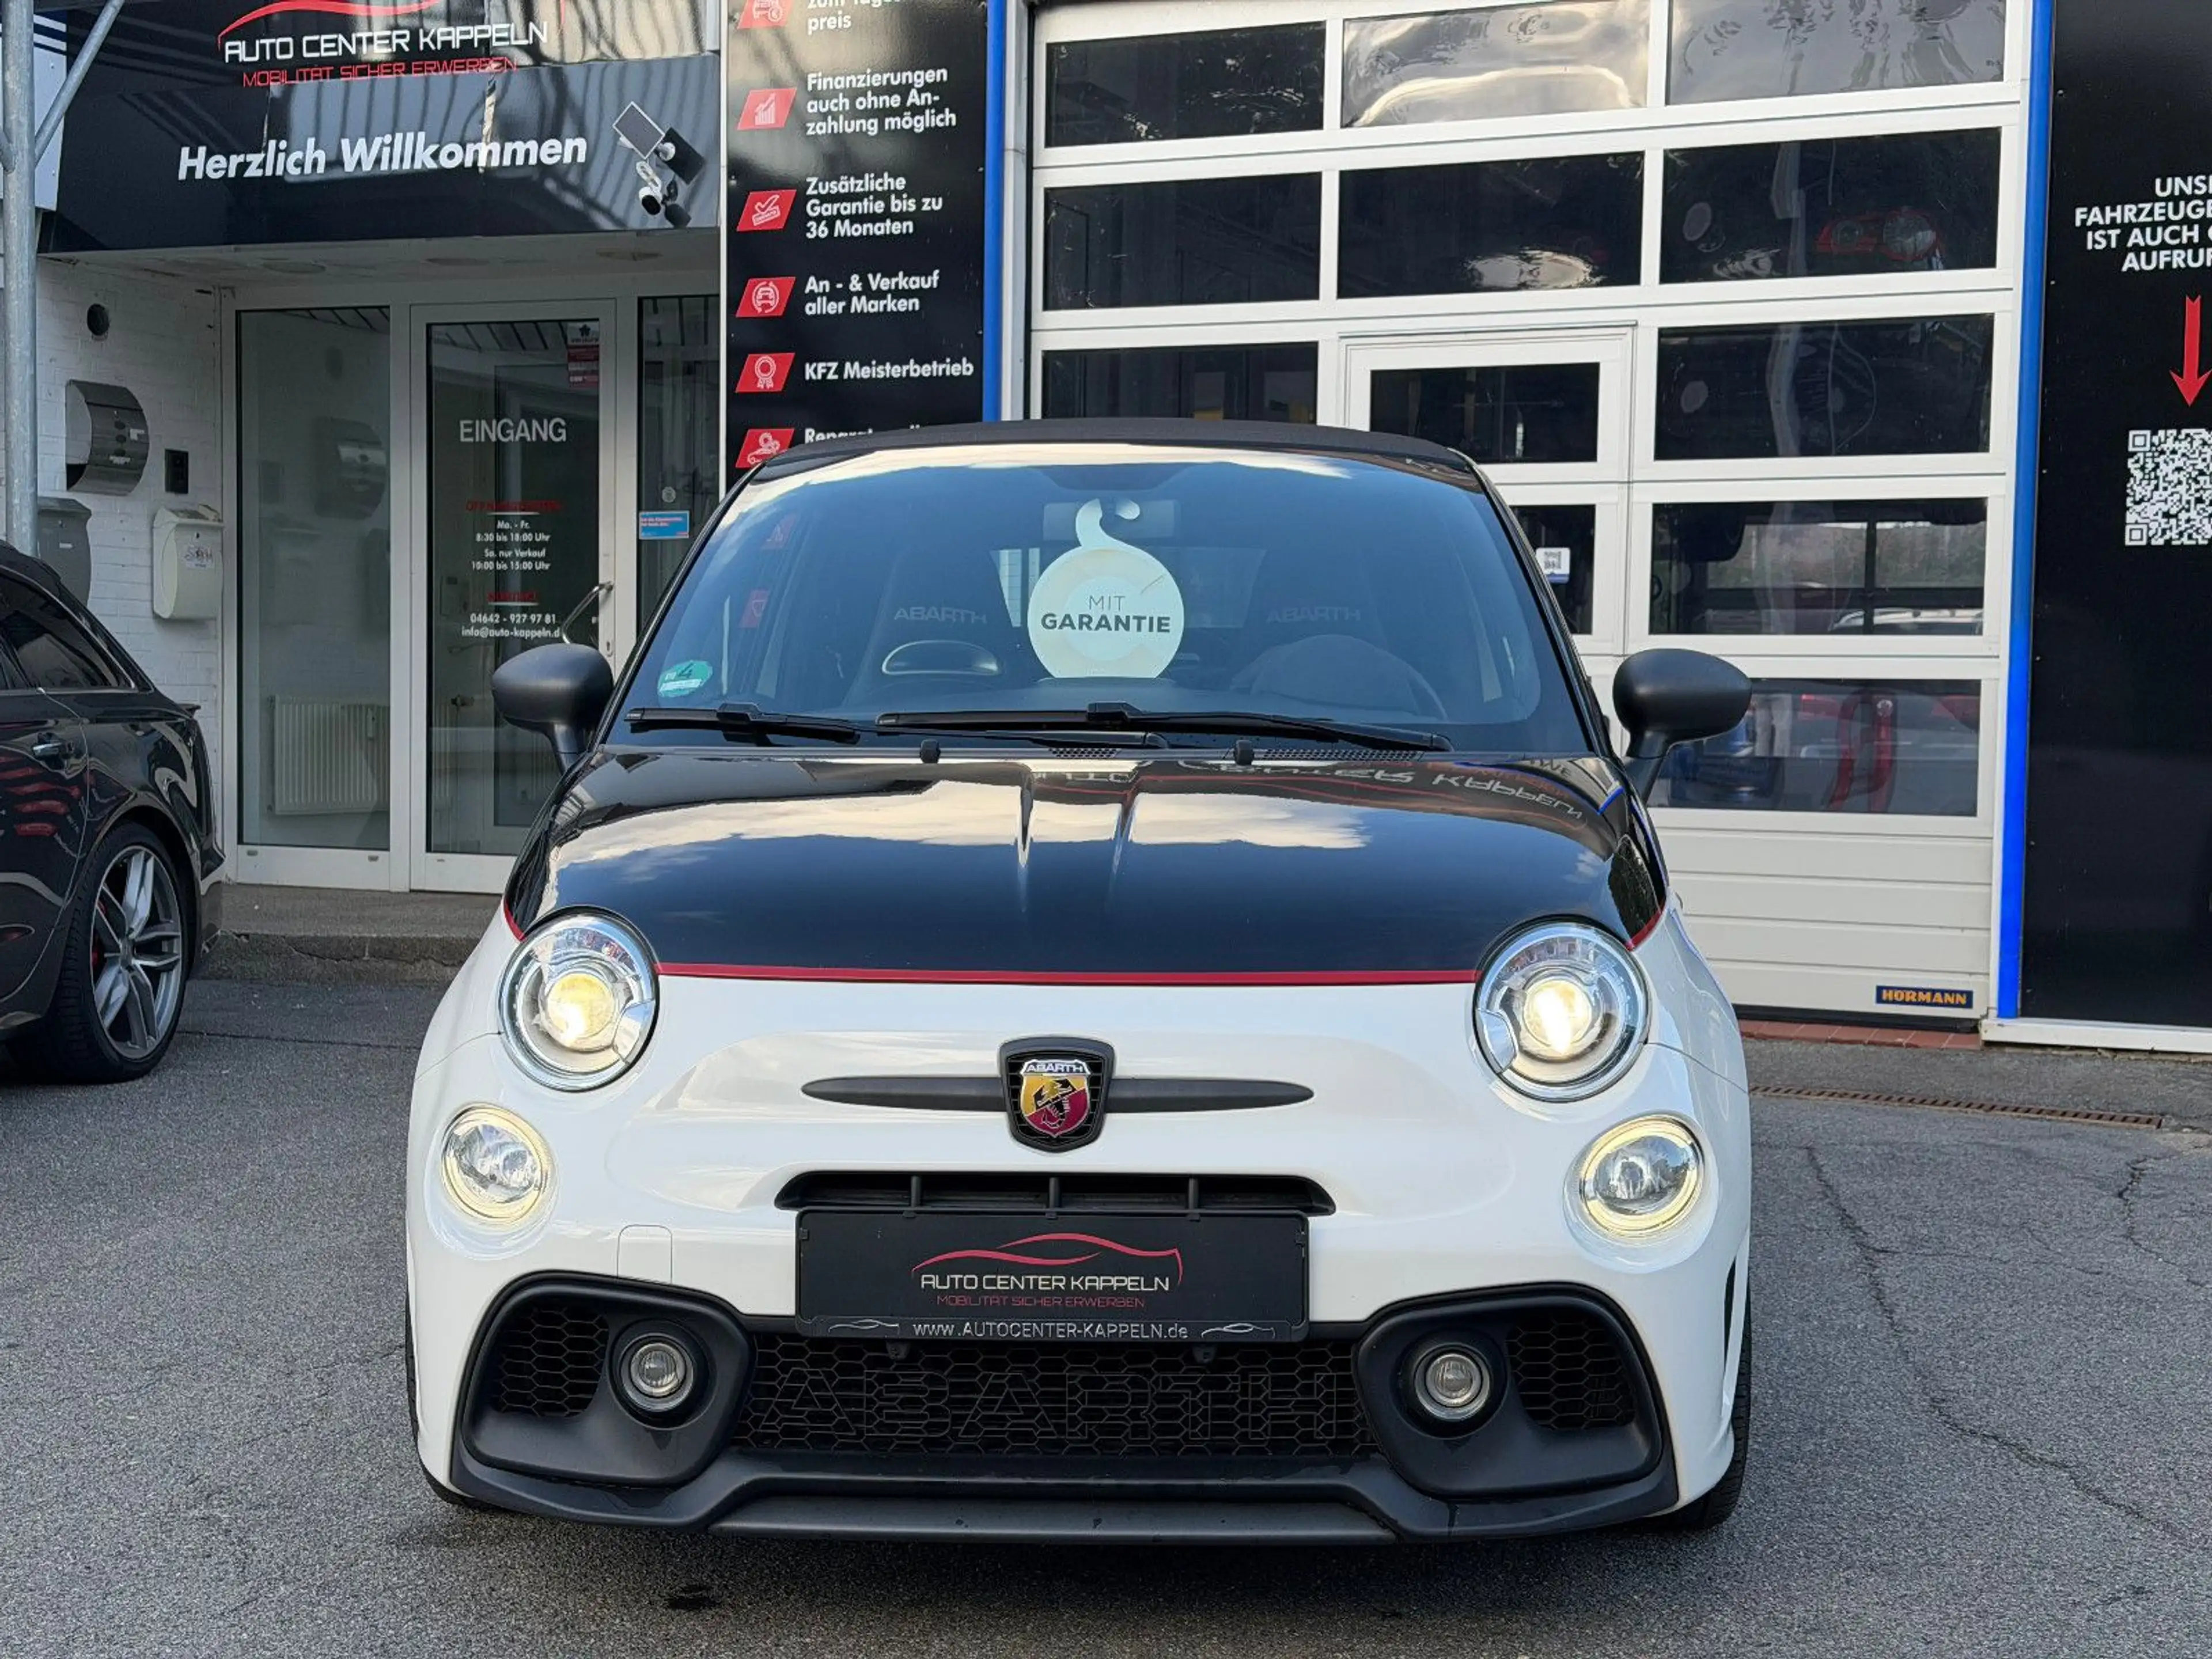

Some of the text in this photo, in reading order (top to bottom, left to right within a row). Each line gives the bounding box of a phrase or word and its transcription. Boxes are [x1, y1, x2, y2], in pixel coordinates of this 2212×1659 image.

[808, 10, 851, 35] preis
[225, 21, 548, 62] AUTO CENTER KAPPELN
[340, 62, 406, 81] SICHER
[412, 56, 518, 76] ERWERBEN
[807, 68, 948, 91] Finanzierungen
[806, 88, 940, 113] auch ohne An-
[806, 108, 956, 136] zahlung möglich
[177, 133, 587, 181] Herzlich Willkommen
[806, 173, 906, 195] Zusätzliche
[806, 194, 943, 218] Garantie bis zu
[806, 218, 914, 240] 36 Monaten
[2086, 229, 2121, 250] IST
[2127, 224, 2199, 247] AUCH
[805, 276, 830, 293] An
[849, 274, 862, 291] &
[867, 269, 940, 291] Verkauf
[805, 294, 920, 316] aller Marken
[805, 357, 974, 380] KFZ Meisterbetrieb
[460, 417, 567, 442] EINGANG
[497, 520, 512, 529] Mo.
[496, 532, 507, 541] bis
[535, 532, 551, 541] Uhr
[484, 548, 497, 558] Sa.
[514, 548, 546, 558] Verkauf
[496, 560, 507, 570] bis
[535, 560, 551, 570] Uhr
[1088, 594, 1126, 612] MIT
[893, 606, 988, 624] ABARTH
[1040, 612, 1171, 633] GARANTIE
[461, 625, 561, 639] info@auto-kappeln.d
[1027, 1063, 1084, 1073] ABARTH
[921, 1274, 1169, 1291] AUTO CENTER KAPPELN
[1012, 1296, 1062, 1307] SICHER
[1066, 1297, 1146, 1308] ERWERBEN
[912, 1321, 1188, 1340] www.AUTOCENTER-KAPPELN.de
[763, 1367, 1336, 1439] ABARTH
